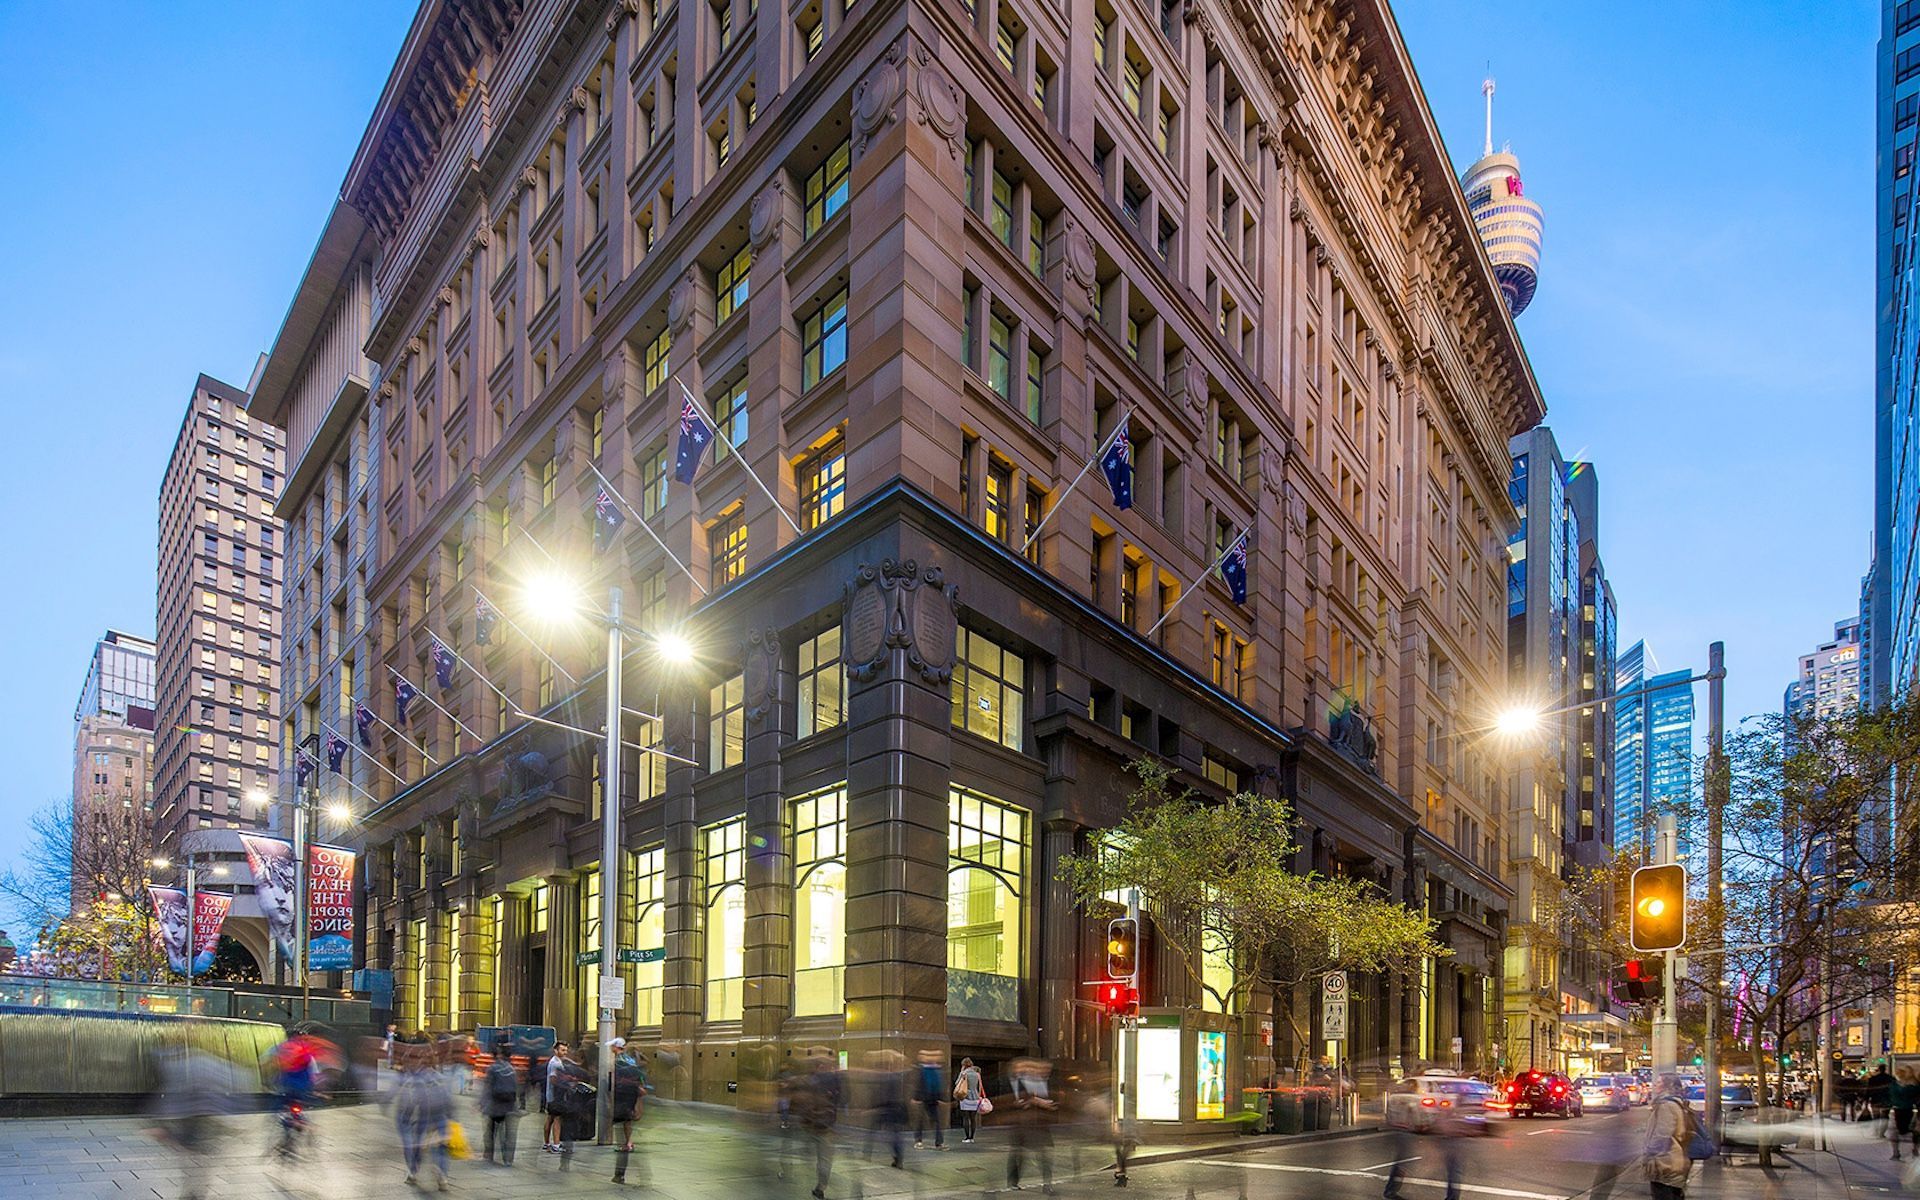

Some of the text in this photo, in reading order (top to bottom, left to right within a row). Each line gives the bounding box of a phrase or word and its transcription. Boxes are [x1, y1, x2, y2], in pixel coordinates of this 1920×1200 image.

[1830, 650, 1855, 663] citi
[629, 950, 644, 958] Pitt
[1328, 978, 1342, 988] 40
